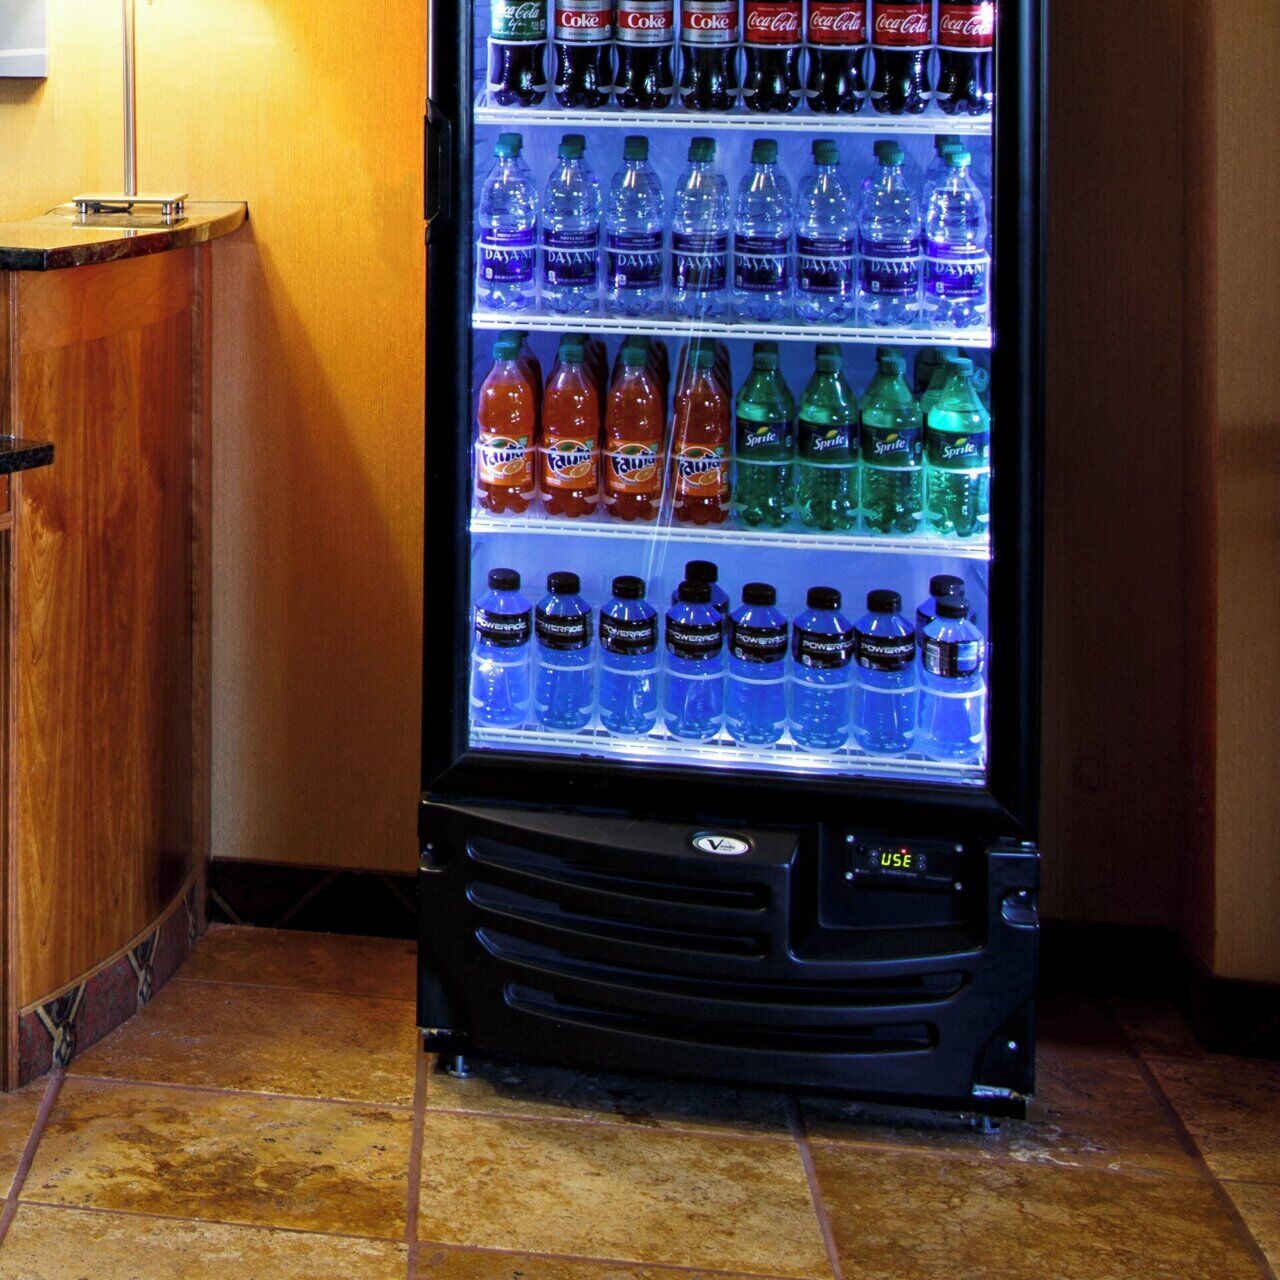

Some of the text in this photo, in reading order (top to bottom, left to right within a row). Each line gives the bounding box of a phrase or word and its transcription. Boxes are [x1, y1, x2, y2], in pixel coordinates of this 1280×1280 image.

[496, 2, 543, 19] ca-Cola
[561, 12, 599, 27] Coke
[627, 13, 666, 29] Coke
[690, 13, 729, 29] Coke
[747, 11, 799, 31] Coca-Cola
[810, 10, 862, 31] Coca-Cola
[876, 13, 928, 34] Coca-Cola
[485, 249, 532, 264] DASANI
[548, 251, 595, 266] DASANI
[618, 253, 660, 269] DASAN
[871, 260, 916, 276] DASAN
[745, 432, 776, 447] Sprite
[813, 435, 845, 451] Sprite
[874, 438, 906, 454] Sprite
[942, 442, 975, 459] Sprite
[477, 619, 526, 631] OWERADE
[881, 853, 912, 868] USE
